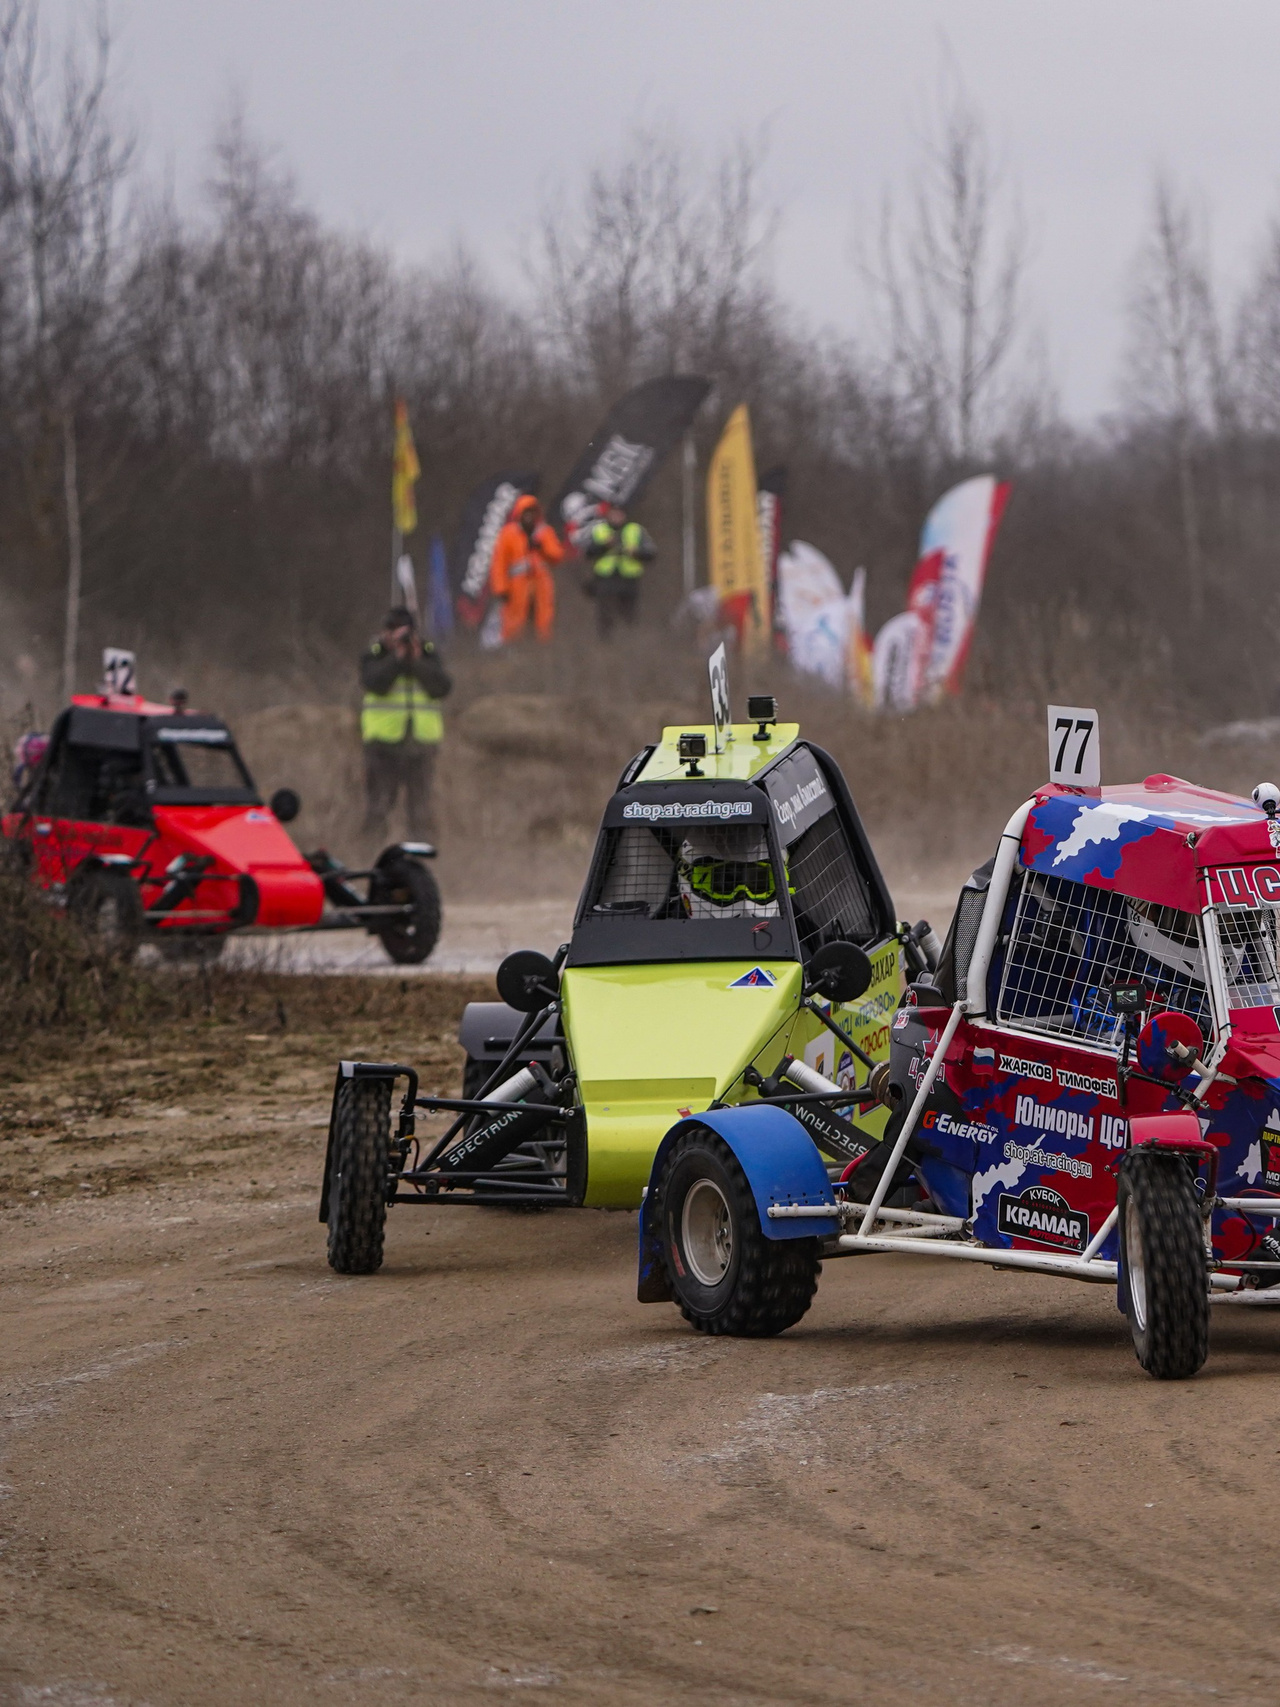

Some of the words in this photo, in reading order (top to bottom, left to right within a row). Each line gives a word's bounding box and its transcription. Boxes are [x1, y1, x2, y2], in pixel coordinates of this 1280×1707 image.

[712, 656, 731, 733] 33
[1054, 717, 1094, 774] 77
[623, 800, 753, 821] shop.at-racing.ru
[999, 1054, 1053, 1082] ЖАРКОВ
[1056, 1068, 1118, 1099] ТИМОФЕЙ
[448, 1110, 523, 1167] SPECTRUM
[795, 1103, 868, 1156] SPECTRUM
[1003, 1140, 1093, 1179] shop.at-racing.ru
[1029, 1189, 1061, 1207] КУБОК
[1006, 1204, 1081, 1239] KRAMAR
[1028, 1228, 1080, 1247] MOTORSPORT
